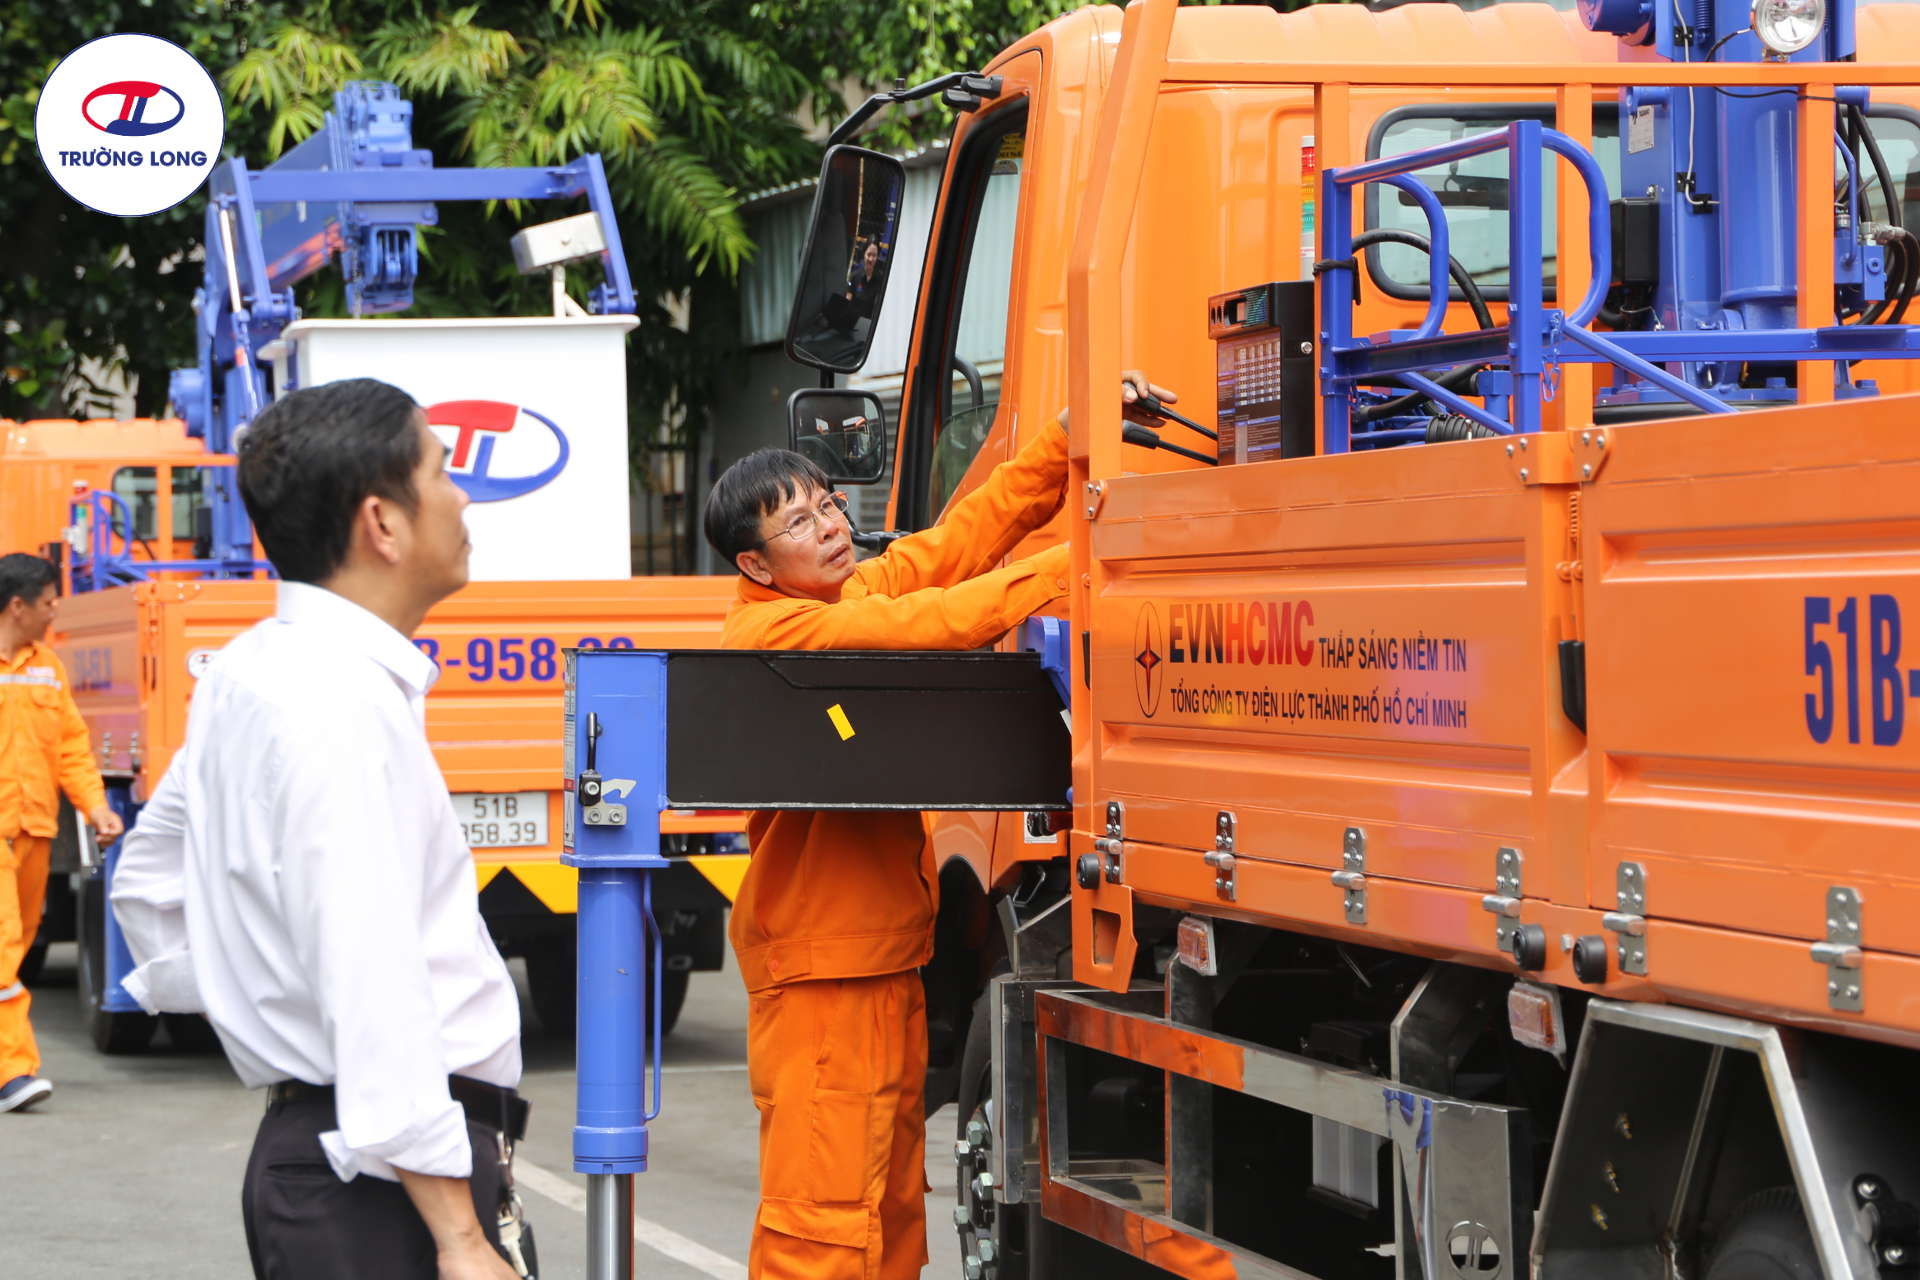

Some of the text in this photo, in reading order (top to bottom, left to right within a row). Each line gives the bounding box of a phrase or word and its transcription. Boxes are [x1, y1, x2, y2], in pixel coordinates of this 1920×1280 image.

[1169, 600, 1314, 667] EVNHCMC
[1358, 629, 1398, 670] SÁNG
[1402, 630, 1438, 671] NIỀM
[1443, 638, 1467, 672] TIN
[1170, 678, 1467, 728] TỔNG CÔNG TY ĐIỆN LỰC THÀNH PHỐ HỒ CHÍ MINH
[474, 796, 518, 819] 51B
